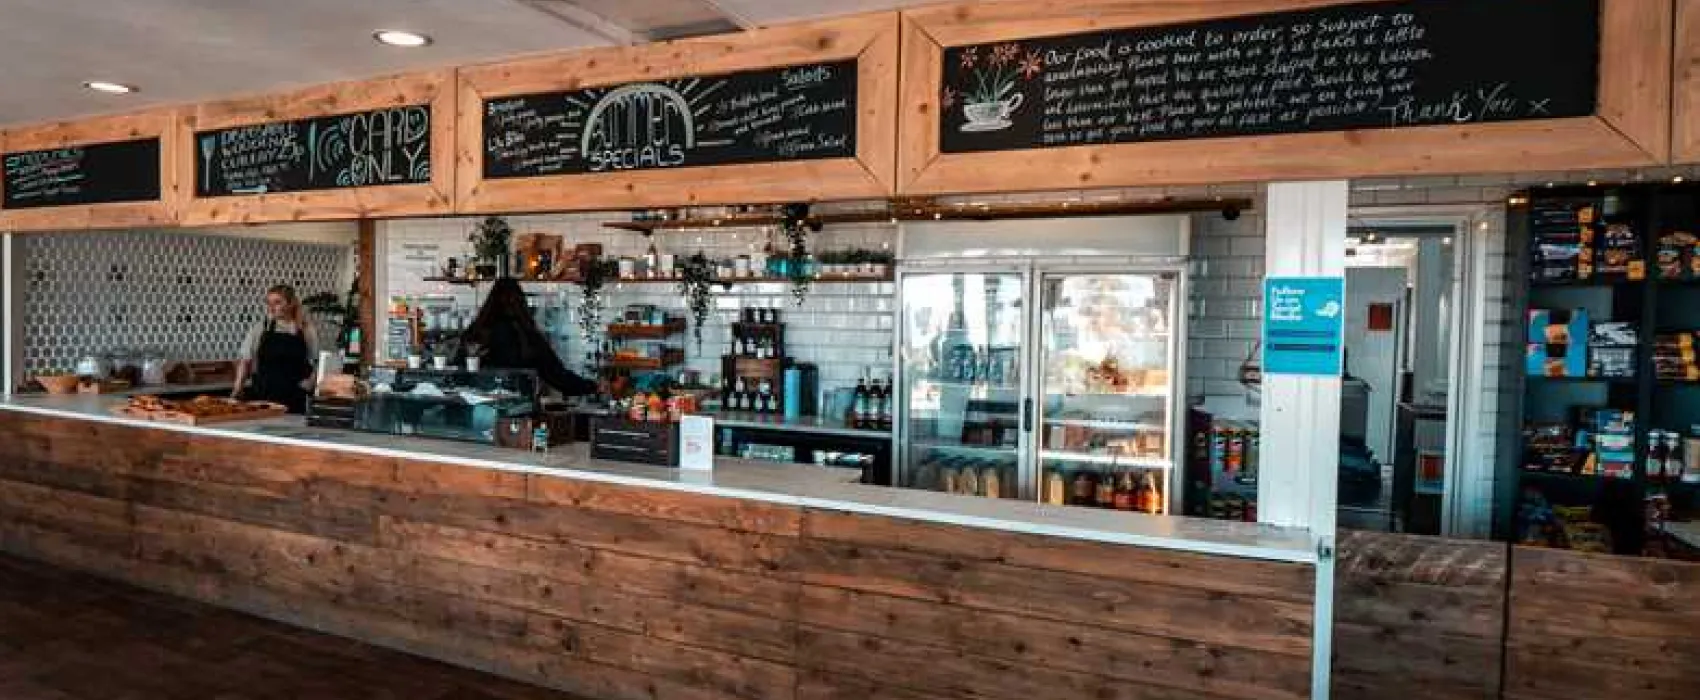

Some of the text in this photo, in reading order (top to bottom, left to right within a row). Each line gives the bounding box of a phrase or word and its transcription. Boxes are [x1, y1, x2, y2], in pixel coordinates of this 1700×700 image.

[1074, 40, 1110, 66] food
[1137, 31, 1196, 53] cooked
[1205, 31, 1222, 46] to
[1317, 13, 1382, 37] Subject
[1391, 13, 1413, 26] to
[1311, 34, 1355, 50] takes
[591, 86, 678, 150] SUMMER
[1478, 83, 1518, 118] You
[350, 108, 429, 156] CARD
[351, 142, 425, 186] ONLY
[589, 144, 685, 171] SPECIALS
